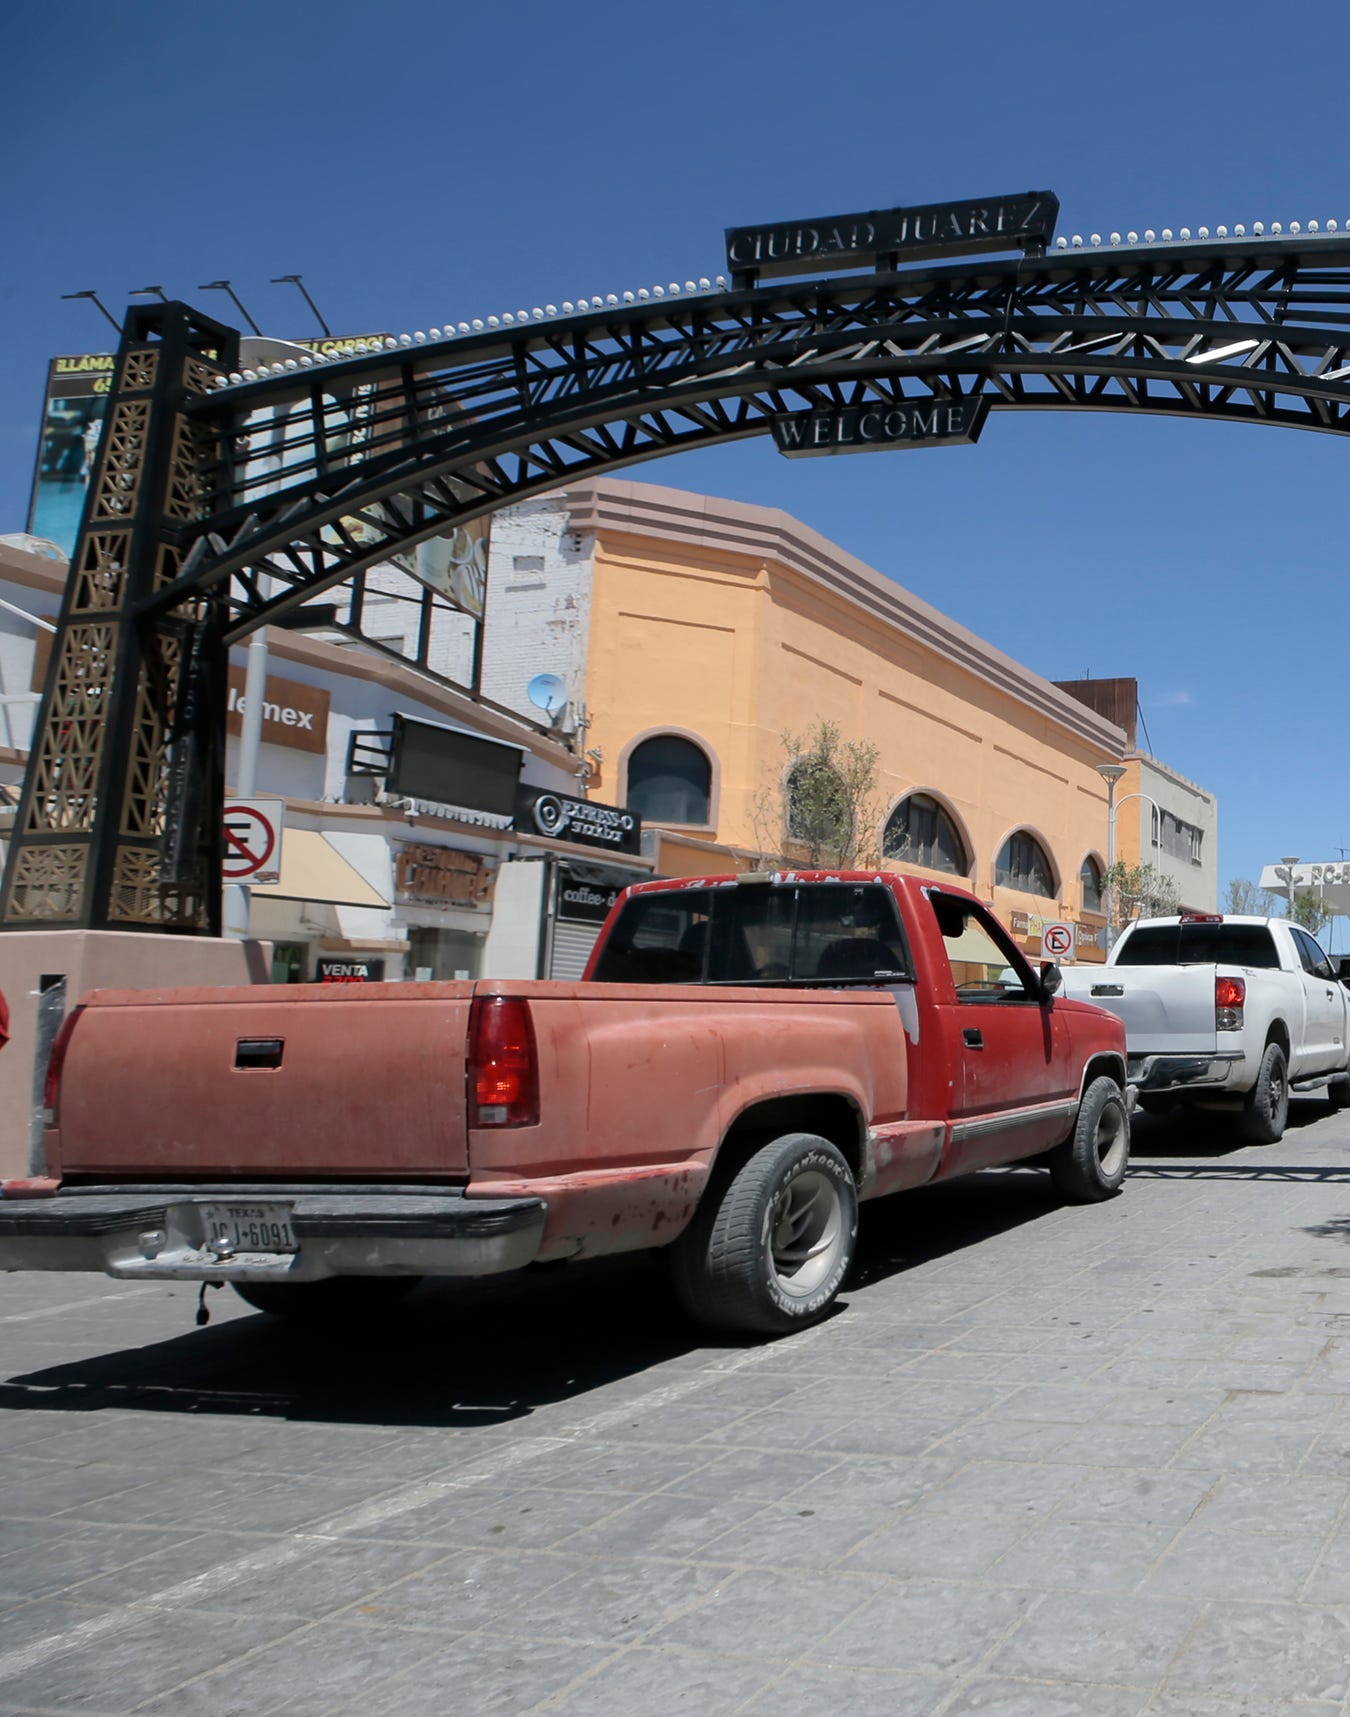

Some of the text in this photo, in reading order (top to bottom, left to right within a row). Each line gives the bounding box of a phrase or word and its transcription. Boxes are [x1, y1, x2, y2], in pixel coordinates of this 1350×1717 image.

[729, 201, 1046, 262] CIUDAD JUAREZ
[779, 406, 964, 446] WELCOME
[322, 964, 368, 977] VENTA
[227, 1208, 265, 1218] TEXAS
